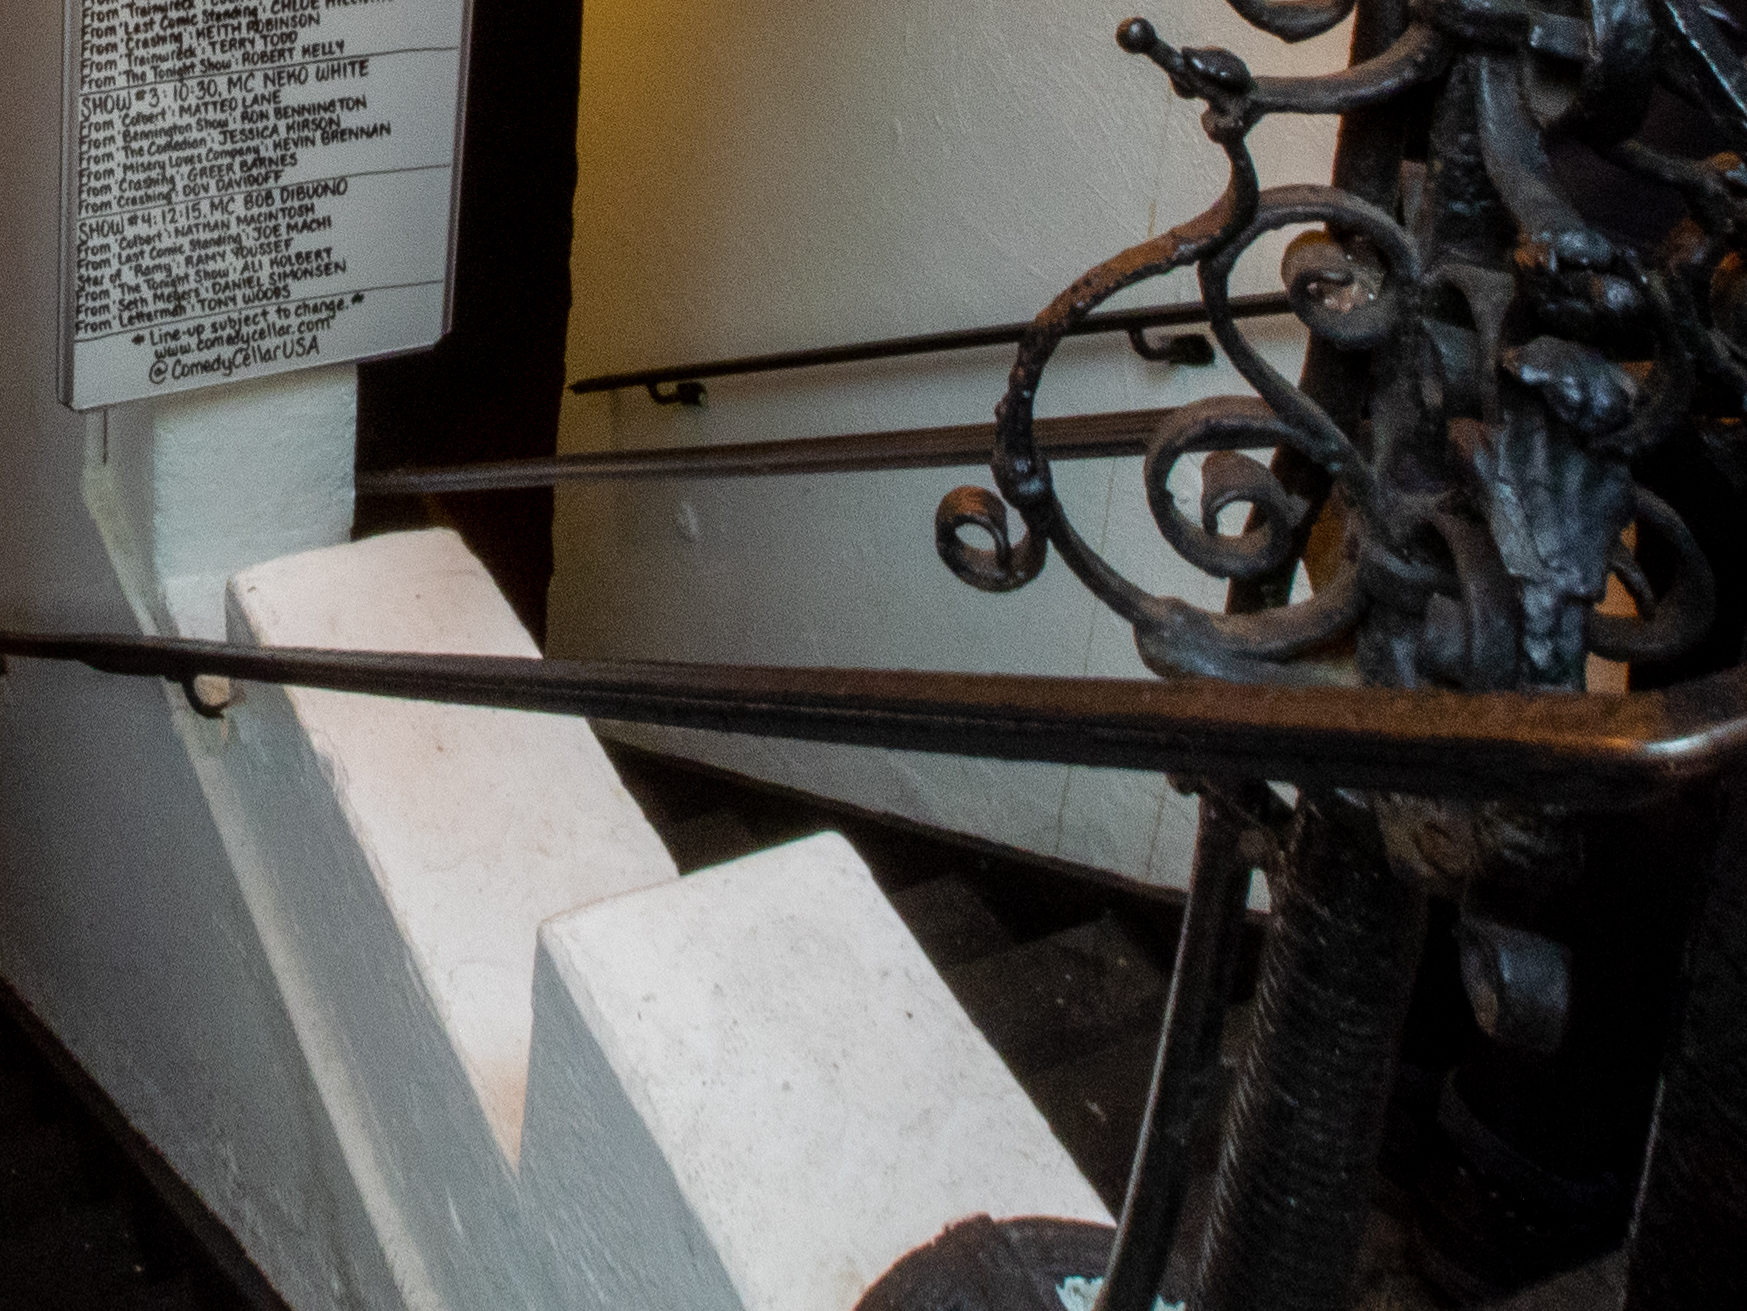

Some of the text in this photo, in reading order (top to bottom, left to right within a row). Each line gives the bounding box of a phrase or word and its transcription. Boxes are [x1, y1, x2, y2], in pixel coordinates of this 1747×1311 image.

[81, 23, 116, 40] From
[81, 39, 118, 58] From
[195, 21, 241, 41] KEITH
[246, 12, 320, 34] ROBINSON
[82, 6, 118, 24] From
[80, 73, 115, 89] From
[149, 61, 195, 85] Tonight
[242, 46, 295, 66] ROBERT
[301, 39, 344, 58] KELLY
[81, 30, 297, 75] From TERRY TODD
[79, 90, 281, 135] From MATTEO LANE
[81, 91, 131, 118] SHOW
[227, 71, 256, 94] MC
[263, 65, 308, 88] NEKO
[315, 58, 369, 82] WHITE
[79, 134, 115, 152] From
[240, 109, 269, 124] RON
[273, 93, 367, 120] BENNINGTON
[79, 150, 114, 167] From
[218, 123, 279, 145] JESSICA
[285, 115, 341, 134] KIRSON
[78, 167, 114, 185] From
[168, 152, 202, 168] Loves
[272, 135, 316, 151] KEVIN
[320, 120, 392, 146] BRENNAN
[78, 182, 112, 200] From
[187, 161, 233, 181] GREER
[239, 151, 297, 173] BARNES
[78, 199, 112, 215] From
[182, 182, 209, 197] DOV
[216, 168, 284, 192] DAVIDOFF
[78, 217, 123, 241] SHOW
[210, 196, 235, 215] MC
[243, 188, 275, 211] BOB
[77, 203, 314, 258] From NATHAN MACINTOSH
[77, 257, 110, 271] From
[149, 243, 185, 259] Comic
[252, 223, 281, 241] JOE
[286, 214, 331, 235] MACHI
[76, 285, 109, 304] From
[143, 272, 189, 295] Tonight
[240, 259, 262, 275] ALI
[76, 303, 110, 318] From
[212, 275, 264, 295] DANIEL
[268, 258, 347, 286] SIMONSEN
[77, 273, 103, 289] Star
[109, 267, 121, 284] of
[184, 249, 226, 268] RAMY
[230, 237, 294, 259] YOUSSEF
[74, 318, 111, 335] From
[196, 293, 237, 312] TONY
[242, 283, 291, 305] WOODS
[210, 307, 269, 337] subject
[275, 304, 291, 319] to
[154, 314, 331, 360] www.comedycellar.com
